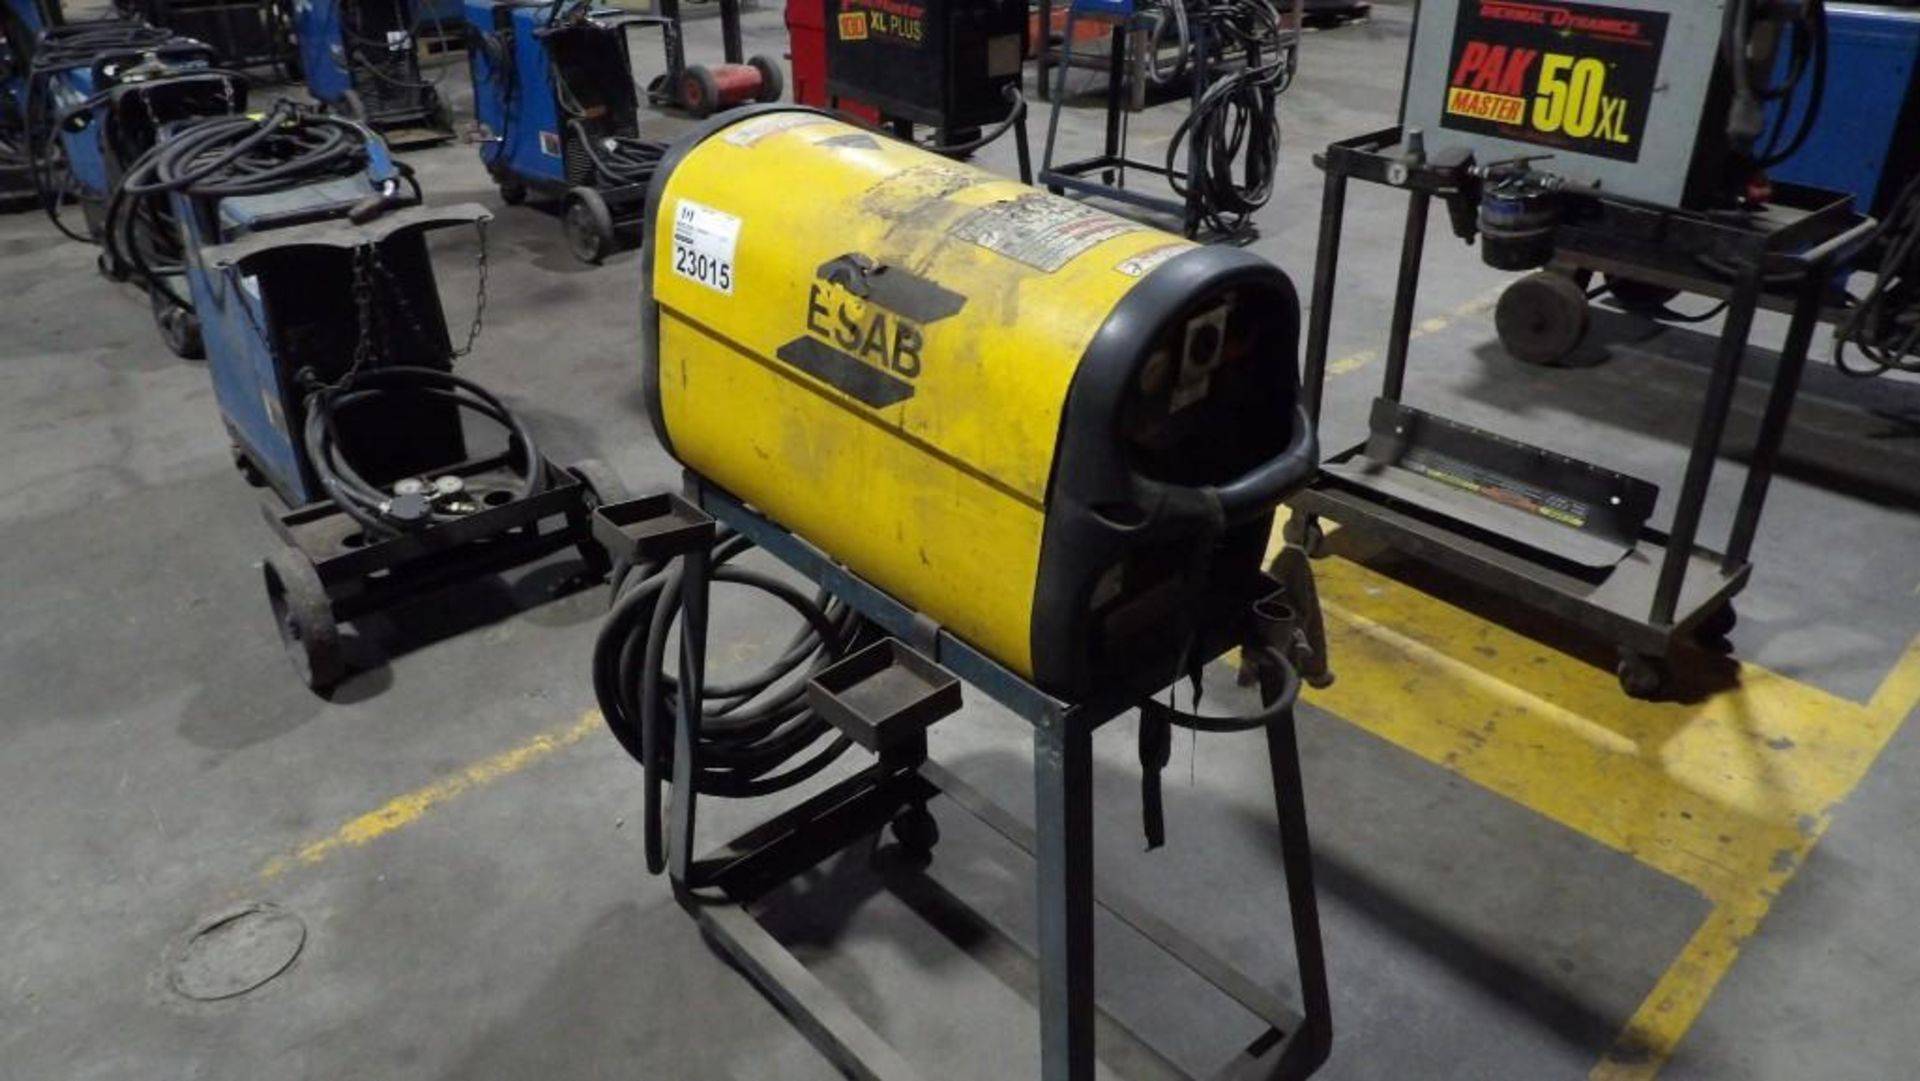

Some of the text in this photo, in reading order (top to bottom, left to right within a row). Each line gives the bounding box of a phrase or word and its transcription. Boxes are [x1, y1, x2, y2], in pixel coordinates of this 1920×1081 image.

[870, 10, 887, 31] XL
[890, 15, 922, 41] PLUS
[1453, 41, 1538, 96] PAK
[1451, 92, 1522, 121] MASTER
[676, 246, 730, 289] 23015
[807, 283, 924, 379] ESAB
